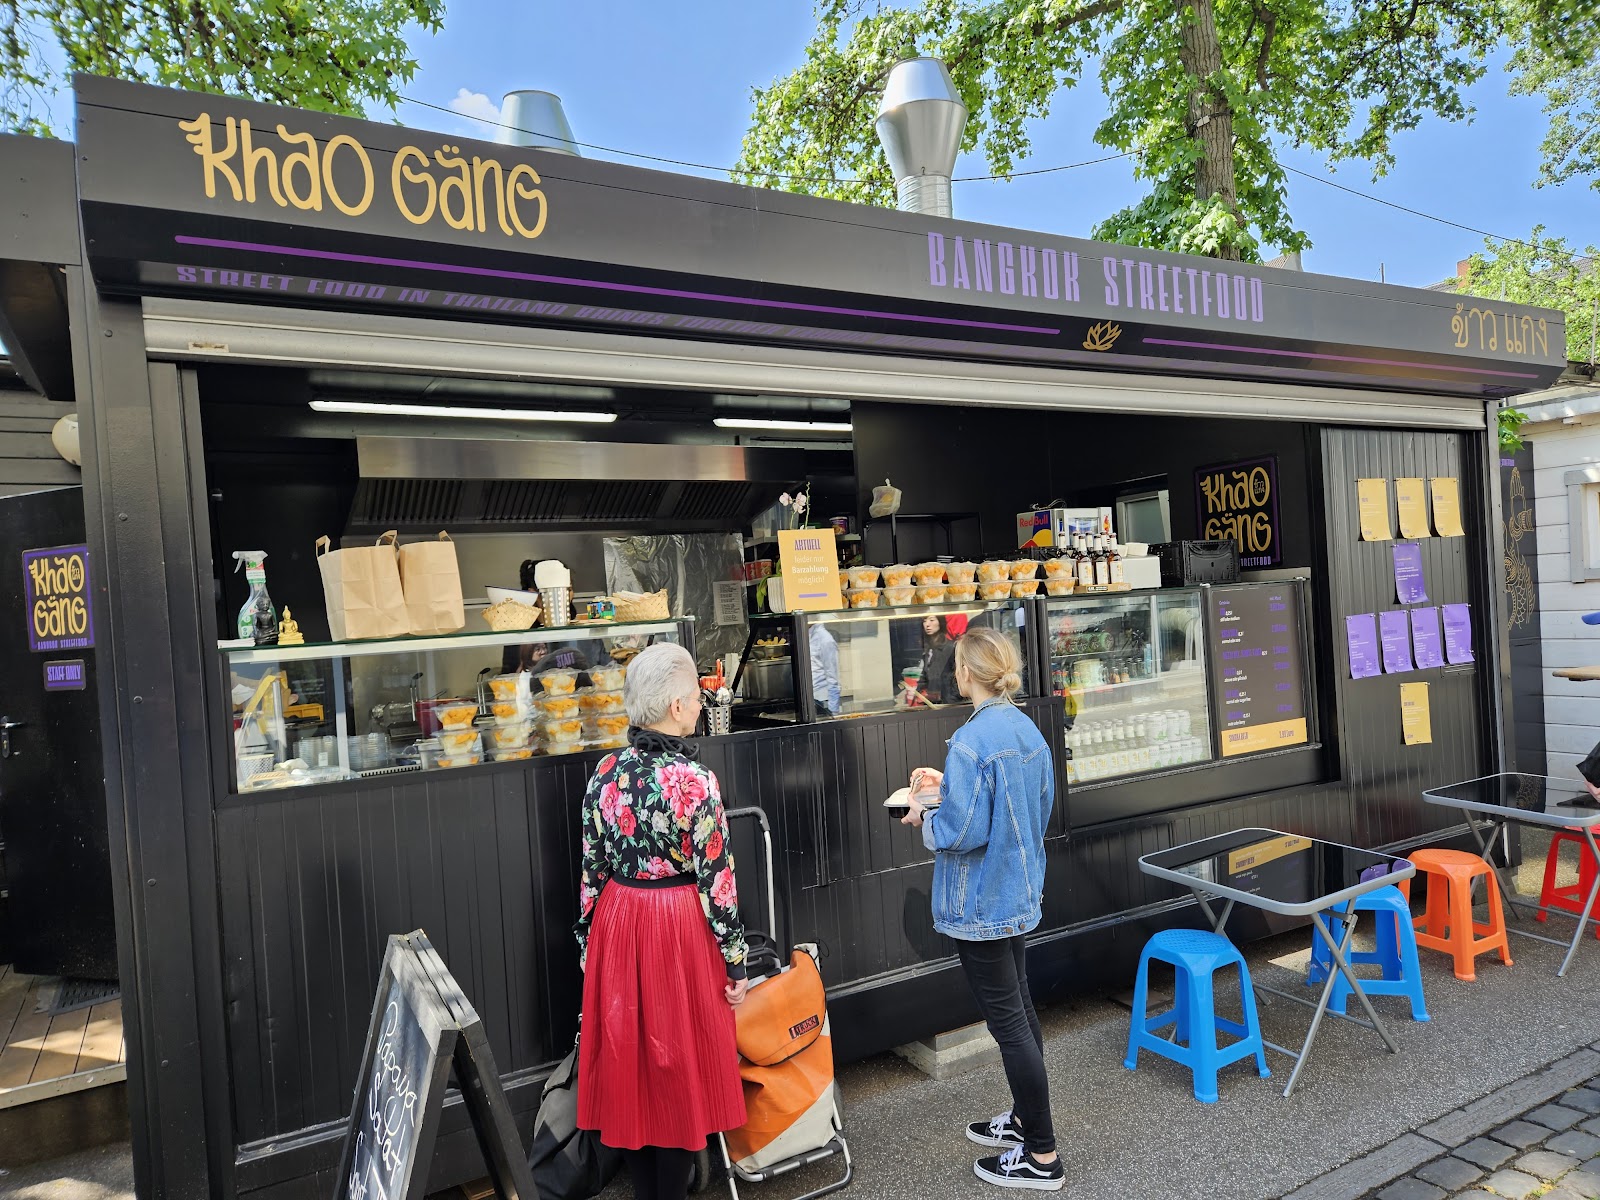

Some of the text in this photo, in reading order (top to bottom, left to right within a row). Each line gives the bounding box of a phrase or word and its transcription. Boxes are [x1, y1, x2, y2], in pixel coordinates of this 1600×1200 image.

[927, 231, 1266, 324] BANGKOK STREETFOOD
[176, 266, 294, 291] STREET
[307, 279, 387, 300] FOOD
[397, 288, 431, 303] IN
[442, 292, 567, 316] THAILAND
[1019, 514, 1049, 528] Red Bull
[794, 538, 821, 551] AKTUELL
[792, 565, 829, 575] Barzahlung
[798, 576, 825, 585] möglich!
[47, 665, 81, 681] STAFF ONLY
[376, 1001, 418, 1136] Papaya
[368, 1071, 407, 1187] Salat
